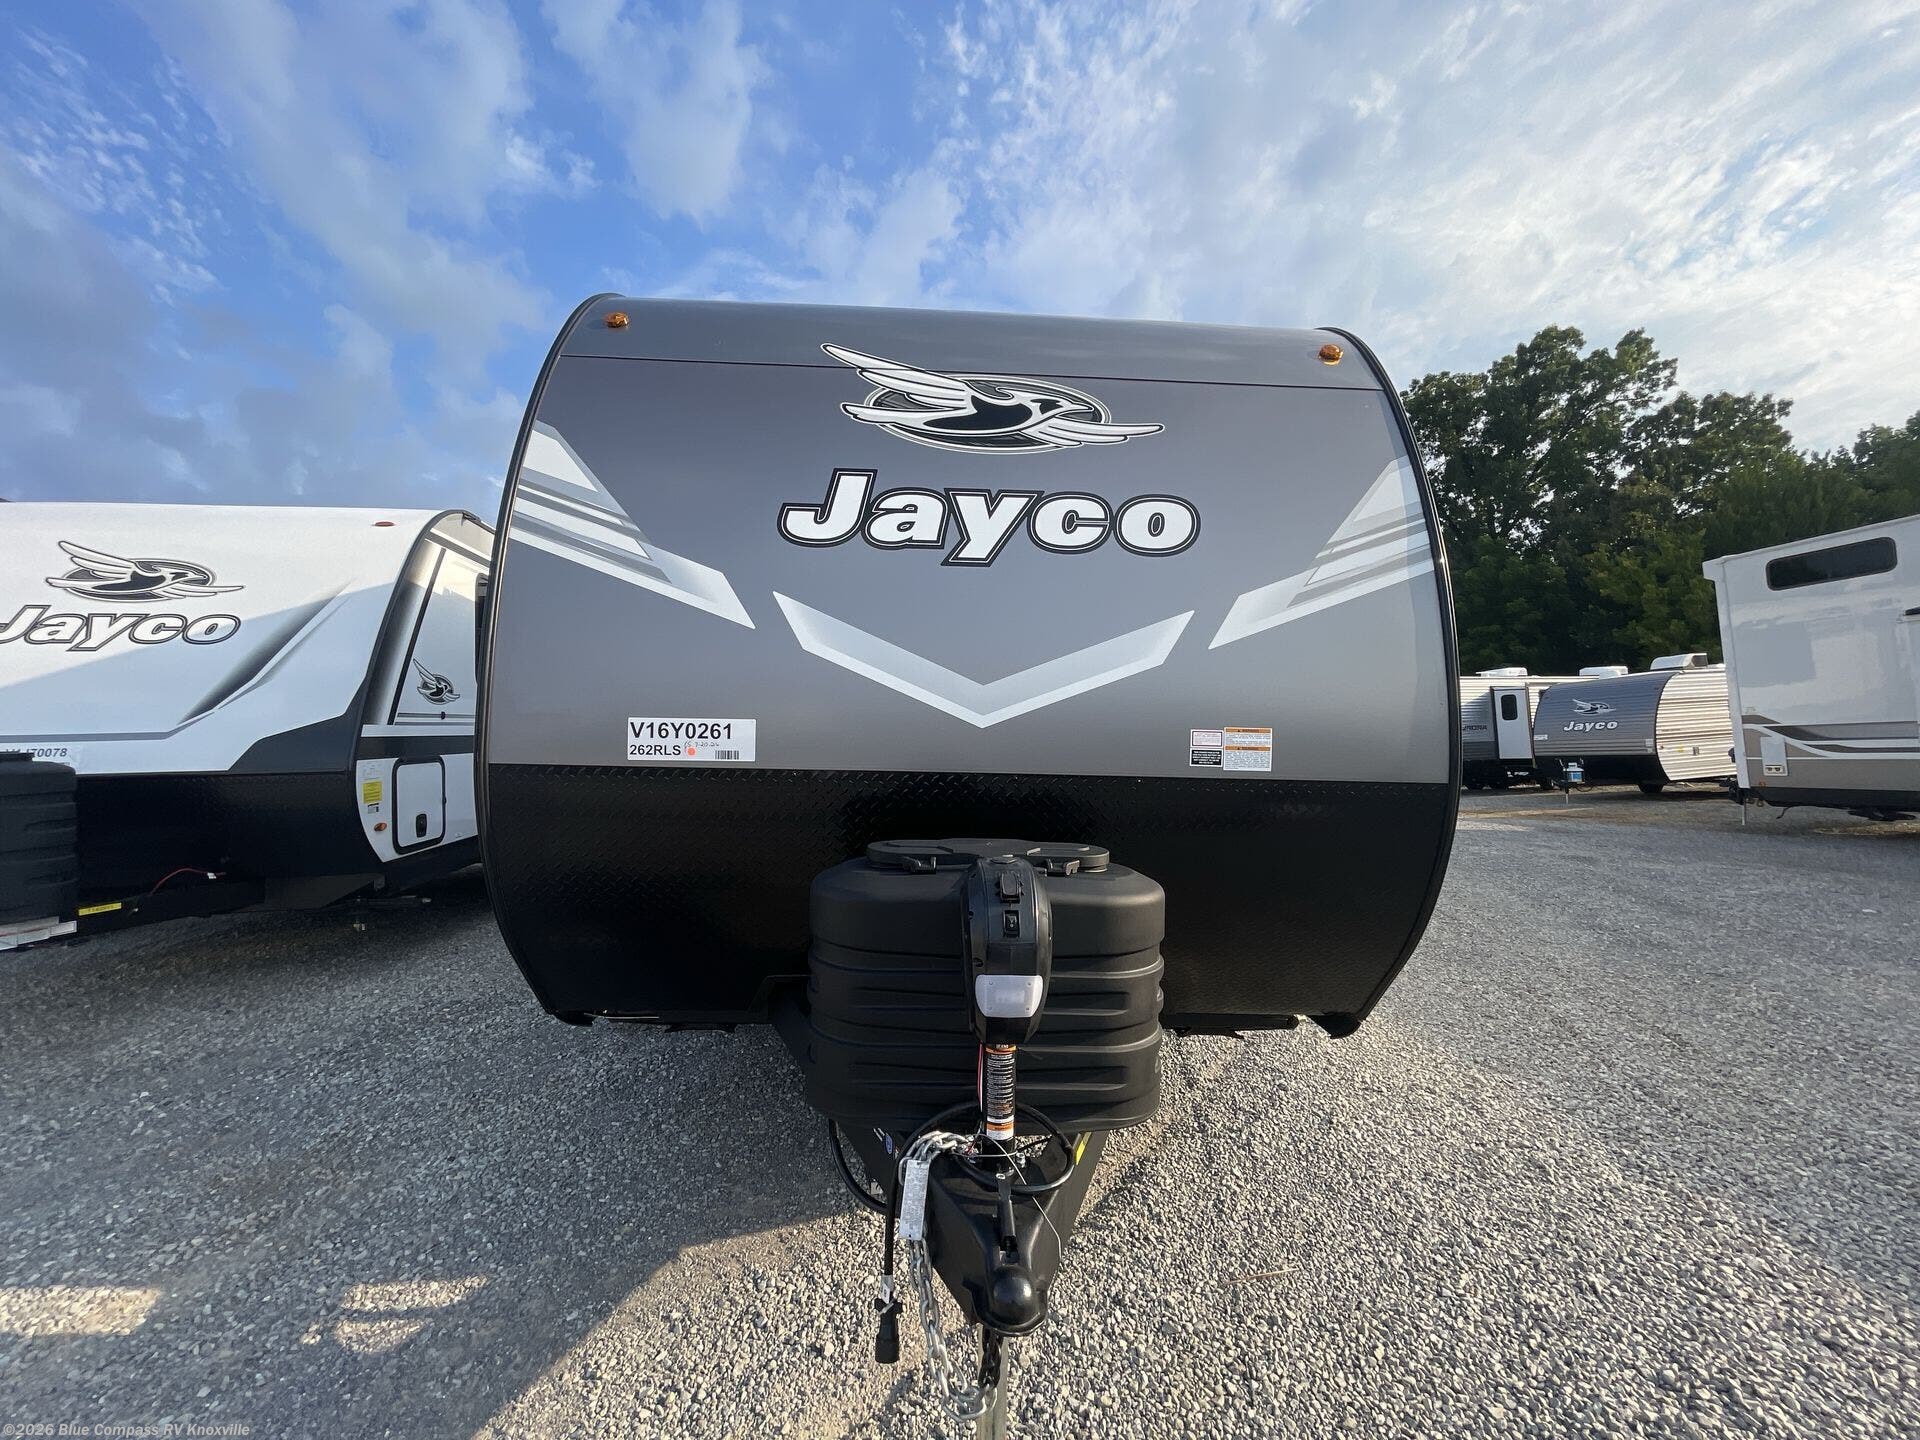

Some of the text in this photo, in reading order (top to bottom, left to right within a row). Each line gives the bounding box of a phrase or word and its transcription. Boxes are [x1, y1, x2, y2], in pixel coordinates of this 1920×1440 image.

[777, 468, 1201, 567] Jayco
[0, 605, 241, 651] Jayco
[629, 722, 732, 739] V16Y0261
[1563, 721, 1619, 732] Jayco
[629, 744, 681, 756] 262RLS
